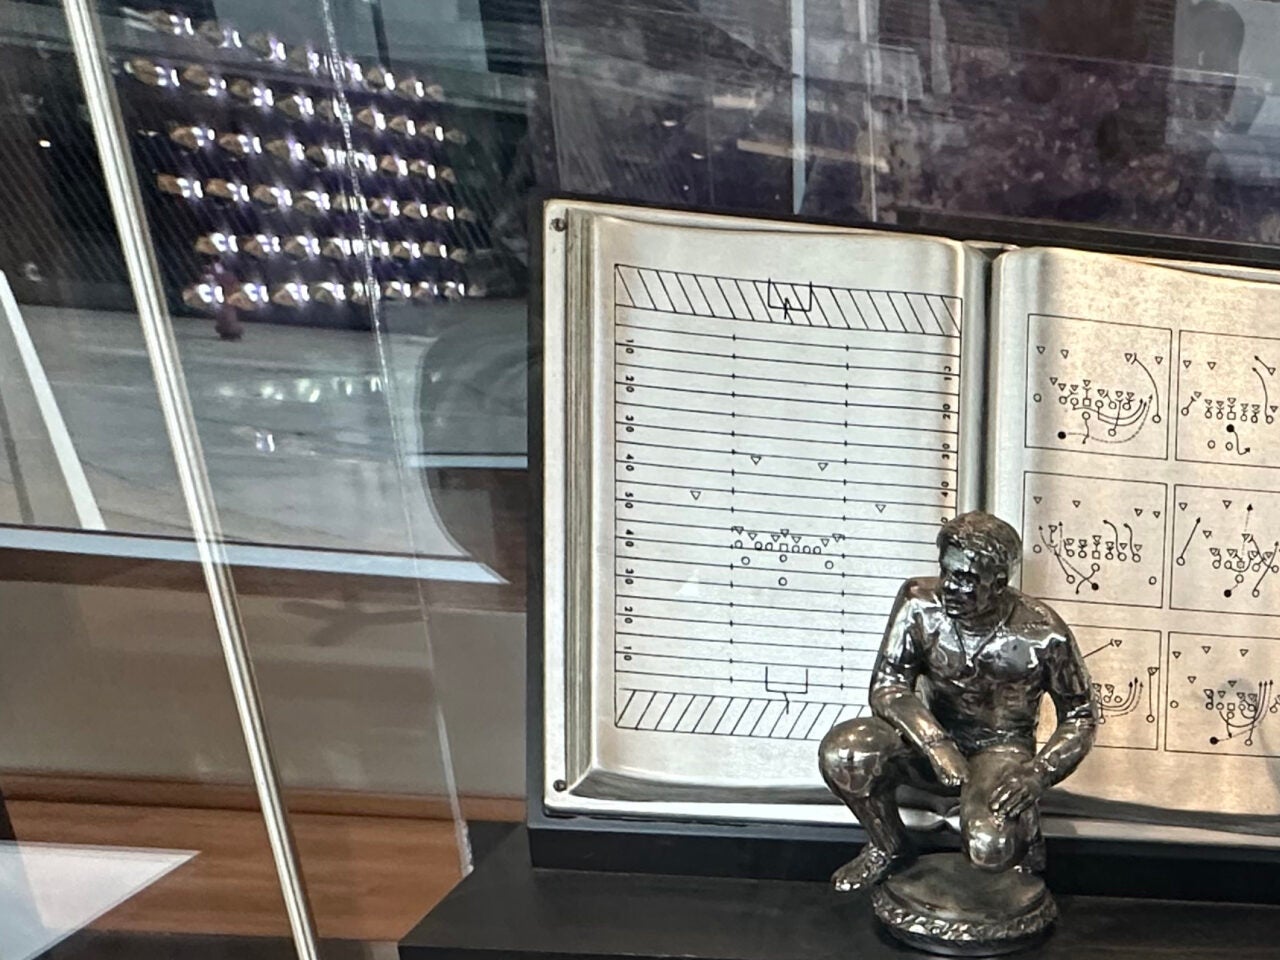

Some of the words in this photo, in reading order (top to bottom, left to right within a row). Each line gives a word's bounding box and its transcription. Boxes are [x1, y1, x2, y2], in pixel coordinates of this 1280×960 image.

[625, 339, 634, 354] 10
[625, 375, 635, 393] 20
[625, 415, 634, 433] 30
[625, 454, 635, 471] 40
[625, 491, 634, 509] 50
[625, 529, 635, 547] 40
[625, 568, 634, 585] 30
[624, 606, 633, 624] 20
[623, 646, 632, 661] 10
